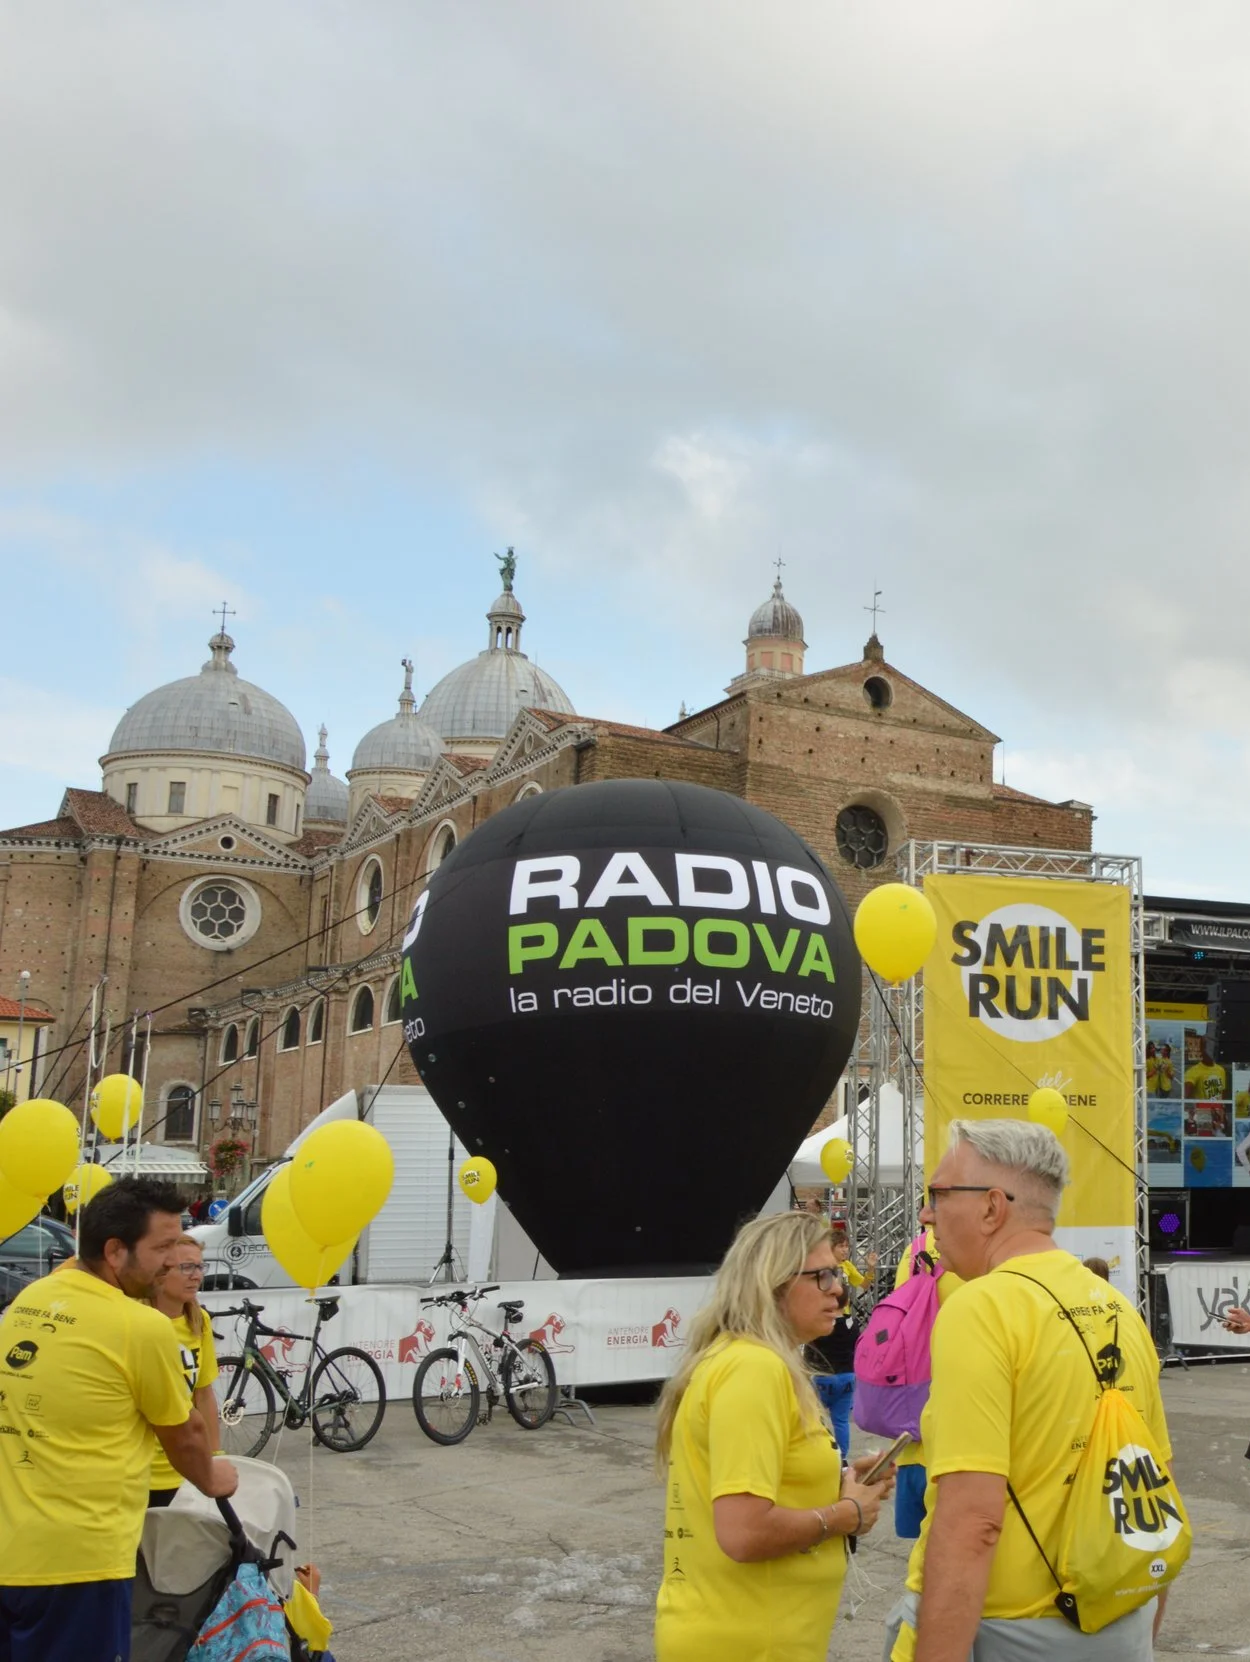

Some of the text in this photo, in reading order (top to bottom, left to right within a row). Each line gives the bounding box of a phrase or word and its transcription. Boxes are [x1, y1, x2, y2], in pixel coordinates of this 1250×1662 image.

[509, 852, 831, 926] RADIO
[508, 916, 835, 984] PADOVA
[951, 920, 1106, 972] SMILE
[509, 978, 833, 1019] la radio del Veneto
[968, 973, 1090, 1022] RUN
[963, 1092, 1029, 1107] CORRERE
[1092, 1305, 1106, 1315] FA
[53, 1313, 77, 1326] BENE
[608, 1326, 649, 1336] ANTENORE
[607, 1336, 649, 1346] ENERGIA
[10, 1346, 32, 1362] Pam
[1113, 1496, 1184, 1535] RUN
[1150, 1564, 1165, 1573] XXL
